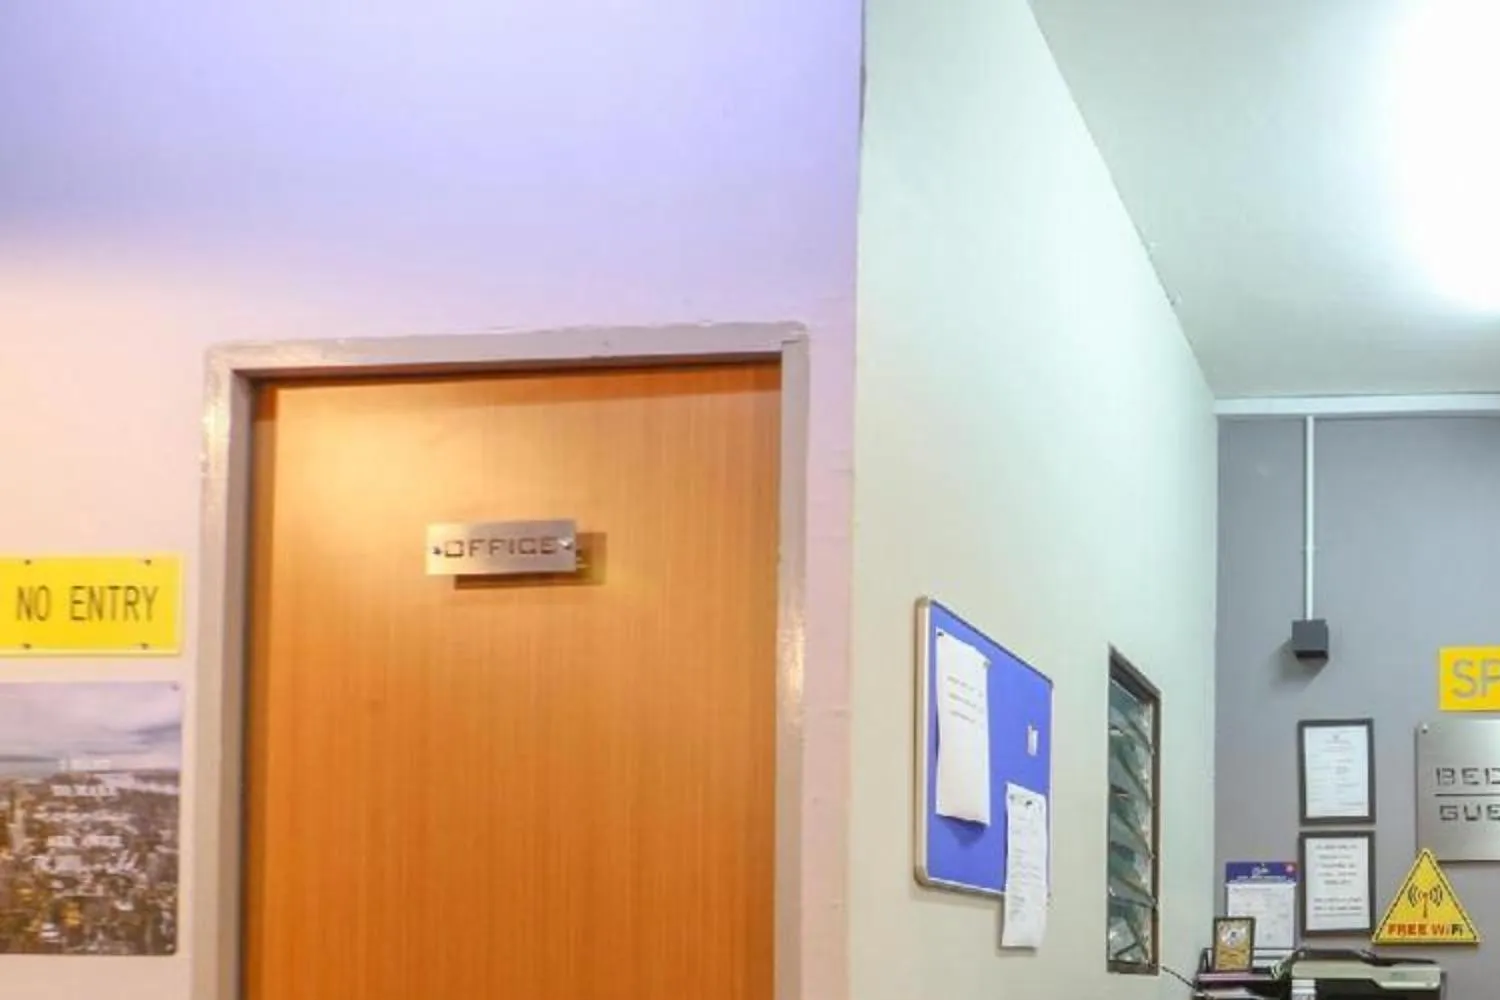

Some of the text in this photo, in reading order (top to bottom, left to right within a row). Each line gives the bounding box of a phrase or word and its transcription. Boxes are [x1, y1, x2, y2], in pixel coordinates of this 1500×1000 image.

[444, 536, 558, 558] OFFICE
[17, 584, 160, 622] NO ENTRY
[1388, 923, 1427, 936] FREE
